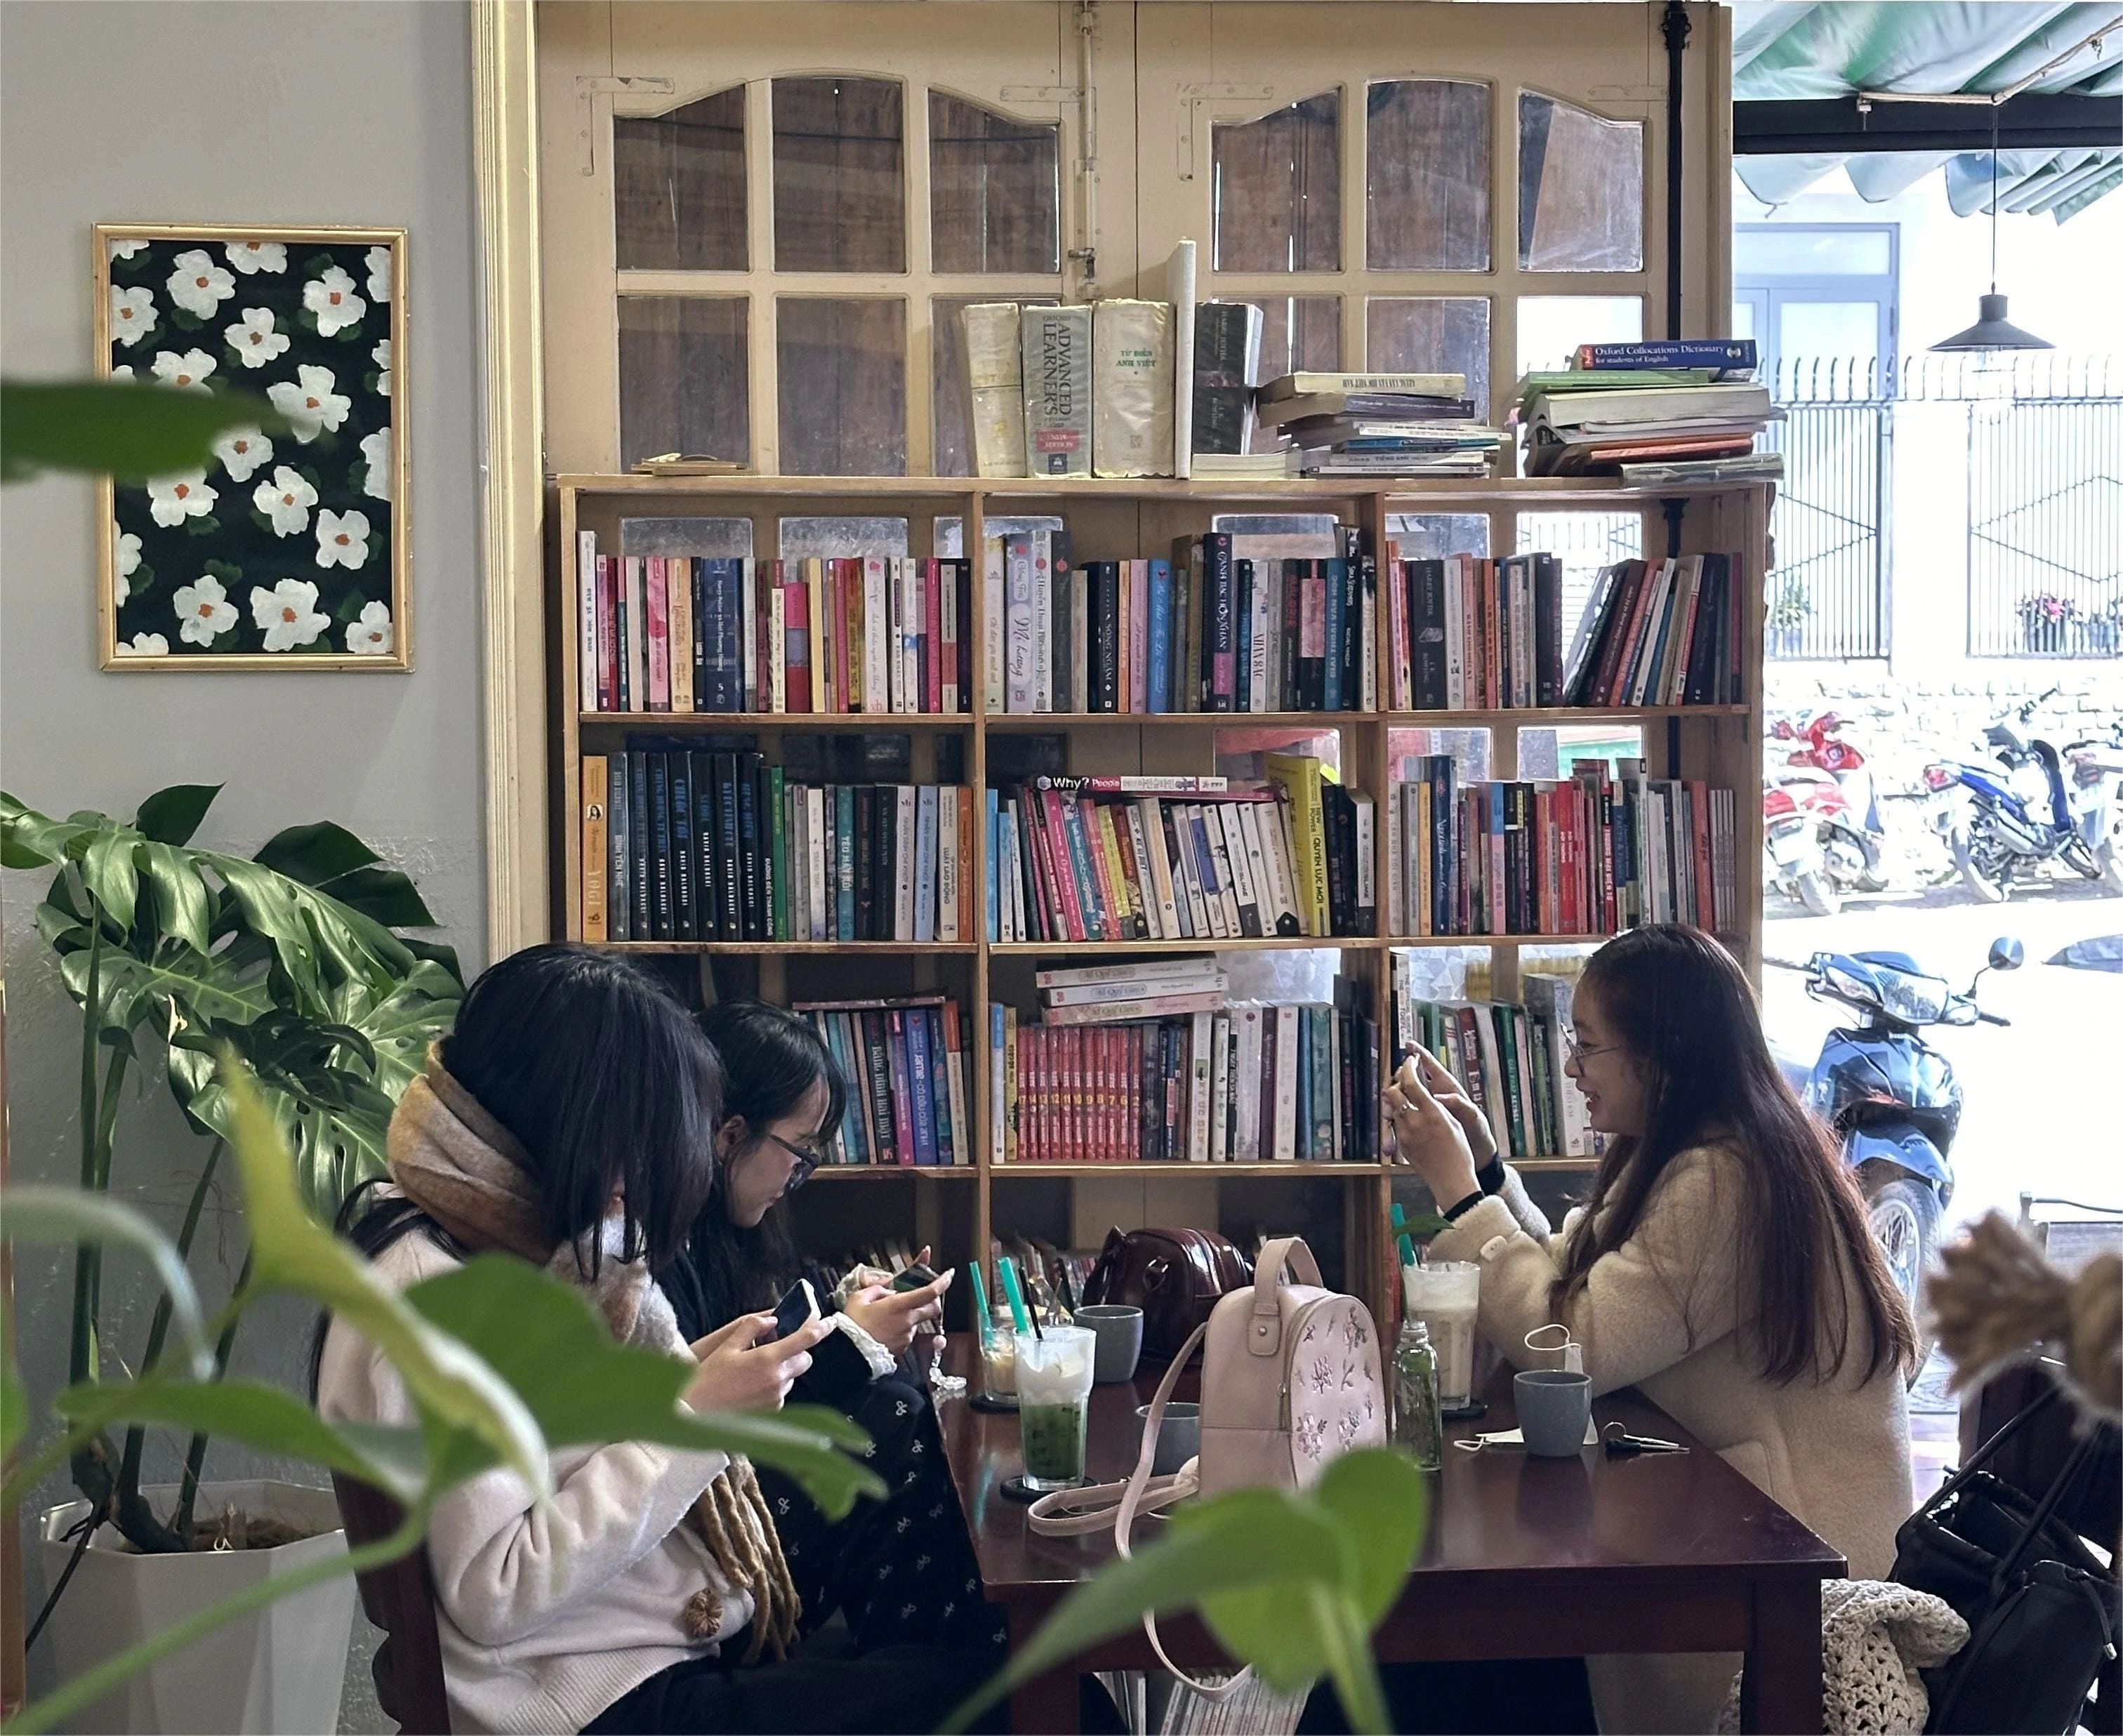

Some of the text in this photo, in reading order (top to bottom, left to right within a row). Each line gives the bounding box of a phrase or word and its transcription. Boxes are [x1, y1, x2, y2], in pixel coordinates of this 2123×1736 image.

[1594, 345, 1724, 356] Oxford Collocations Dictionary
[1043, 322, 1058, 416] LEARNER'S
[1058, 323, 1072, 416] ADVANCED
[1052, 776, 1090, 790] Why?
[588, 869, 602, 906] YOGI
[1051, 1093, 1059, 1104] 12
[1063, 1094, 1071, 1104] 11
[1086, 1094, 1093, 1105] 9
[1097, 1093, 1104, 1104] 8
[1108, 1095, 1115, 1106] 7
